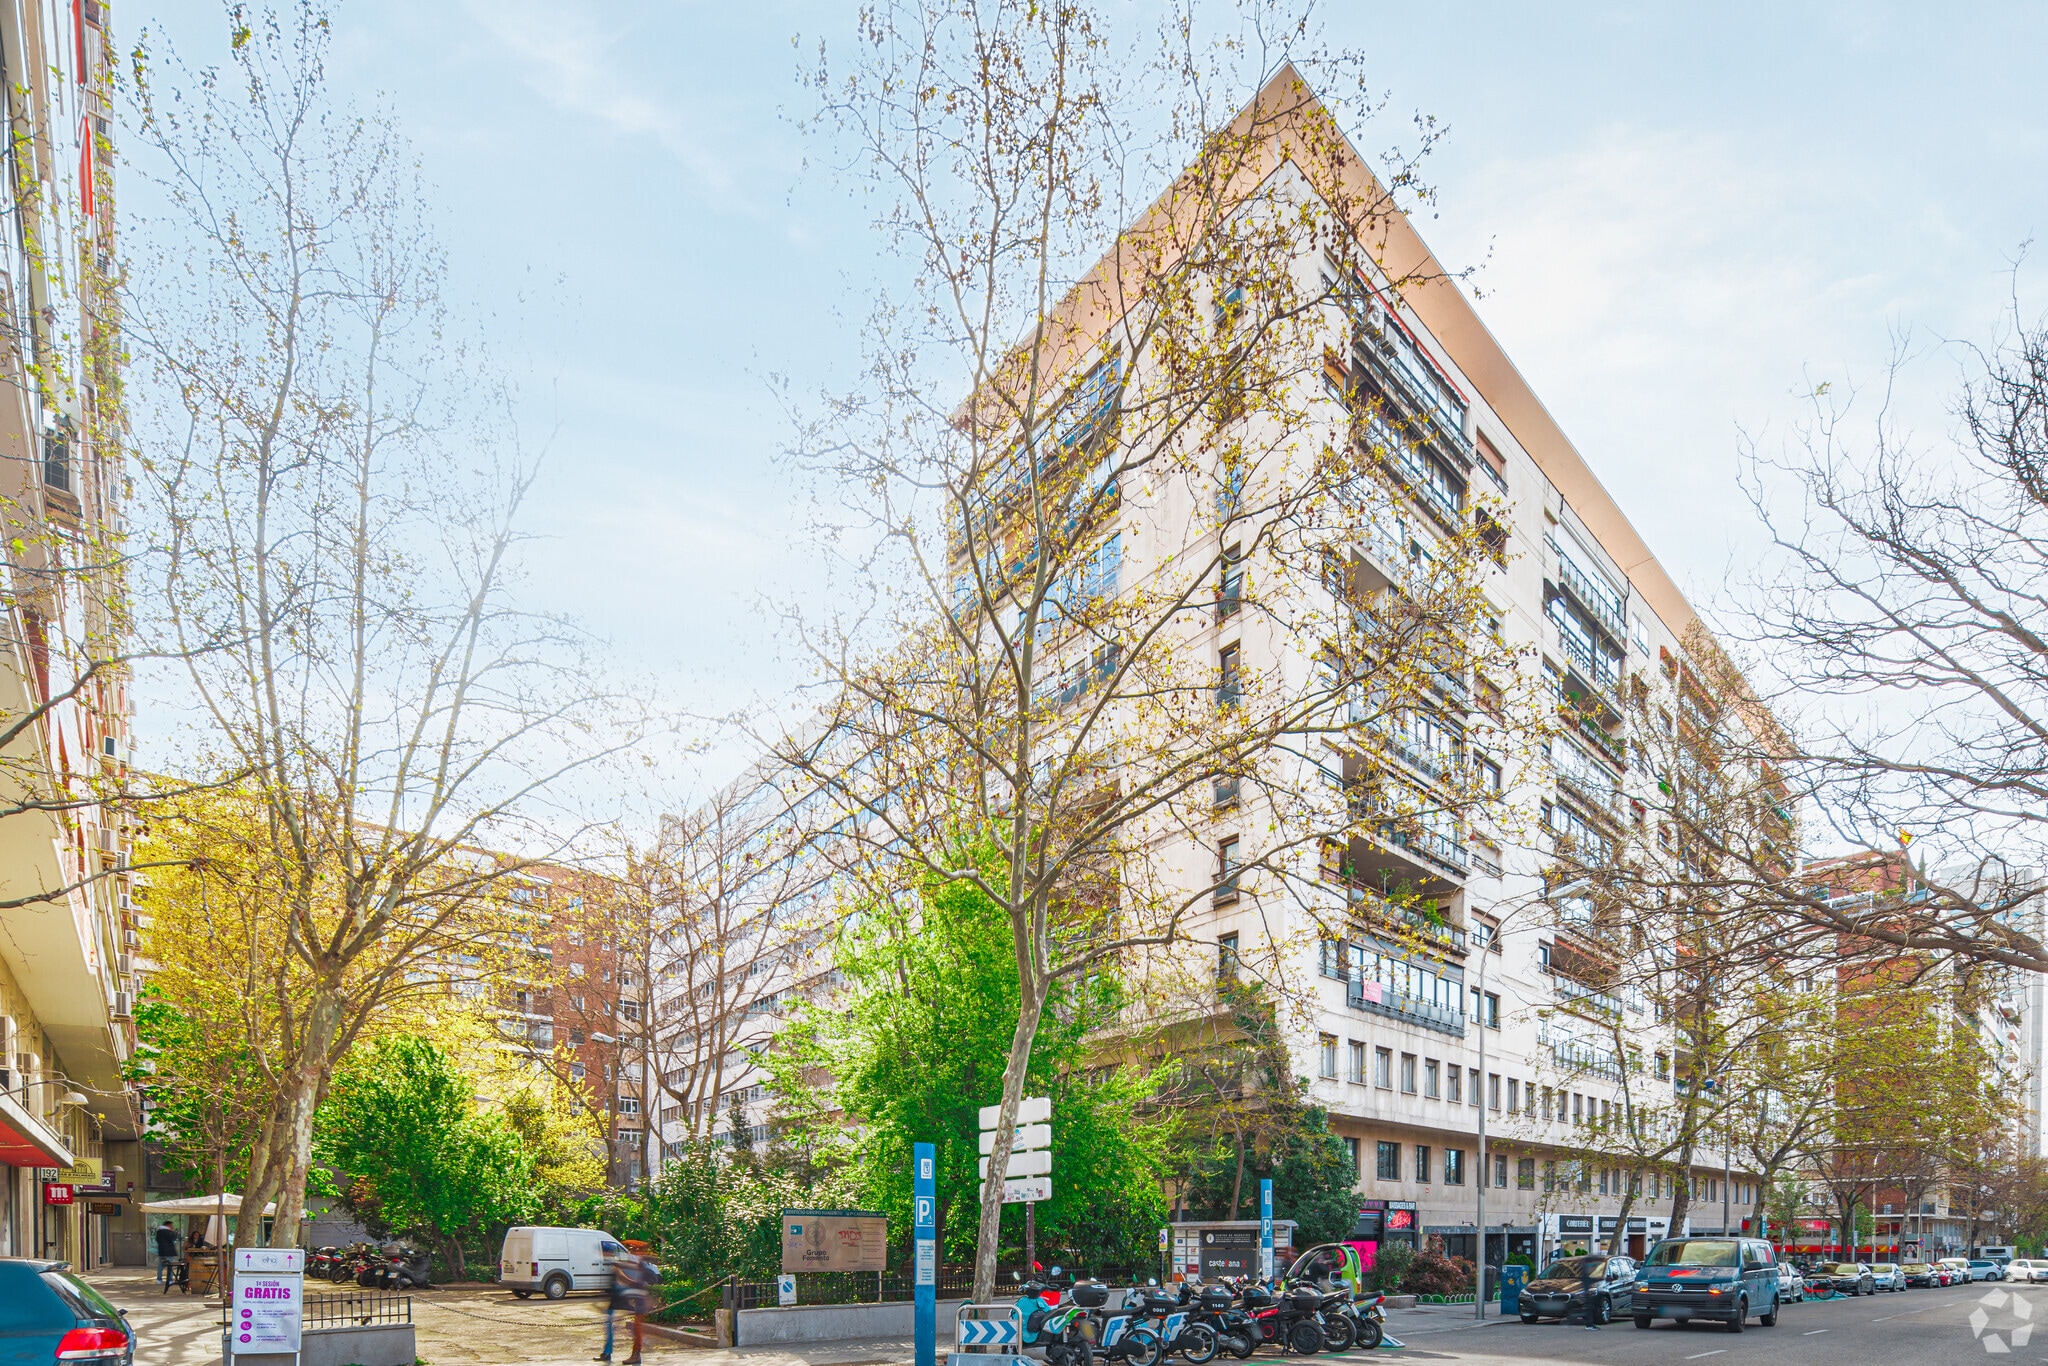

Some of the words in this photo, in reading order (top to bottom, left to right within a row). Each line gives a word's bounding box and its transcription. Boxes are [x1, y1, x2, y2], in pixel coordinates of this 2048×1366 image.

[42, 1168, 56, 1178] 192
[918, 1199, 931, 1223] P
[1263, 1219, 1271, 1236] P
[245, 1287, 290, 1299] GRATIS
